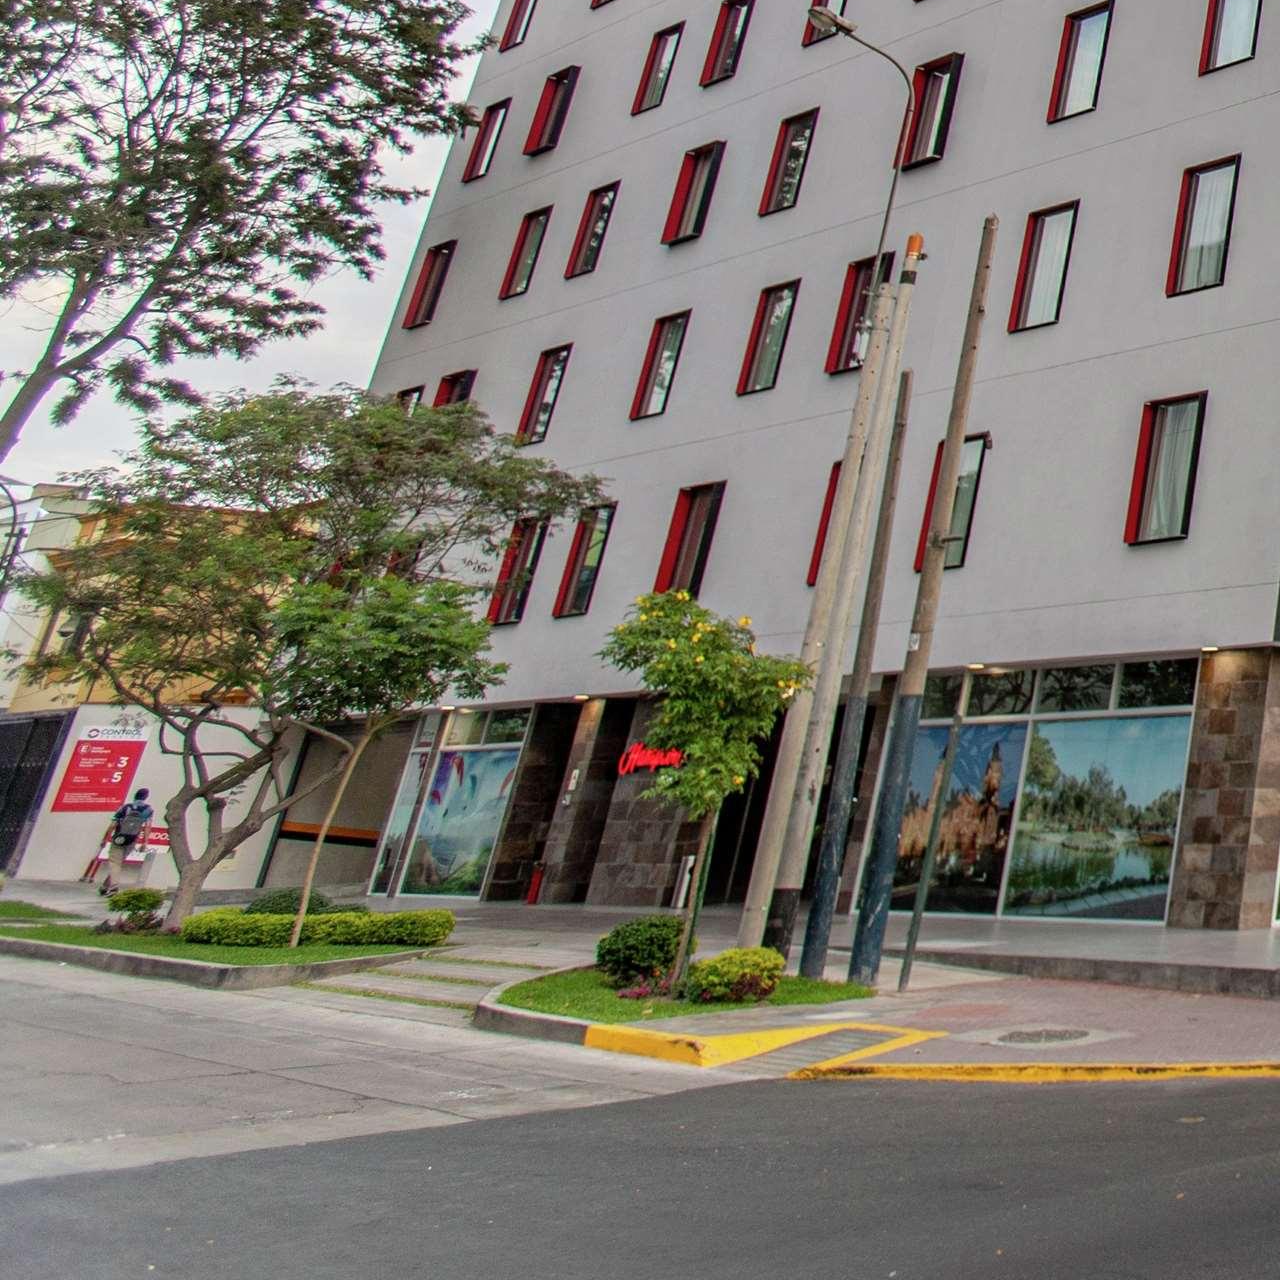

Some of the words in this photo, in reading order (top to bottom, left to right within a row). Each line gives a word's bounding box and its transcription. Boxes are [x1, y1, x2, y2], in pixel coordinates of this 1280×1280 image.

[101, 728, 142, 736] CONTROL
[80, 745, 88, 753] E
[117, 756, 128, 768] 3
[111, 772, 122, 783] 5
